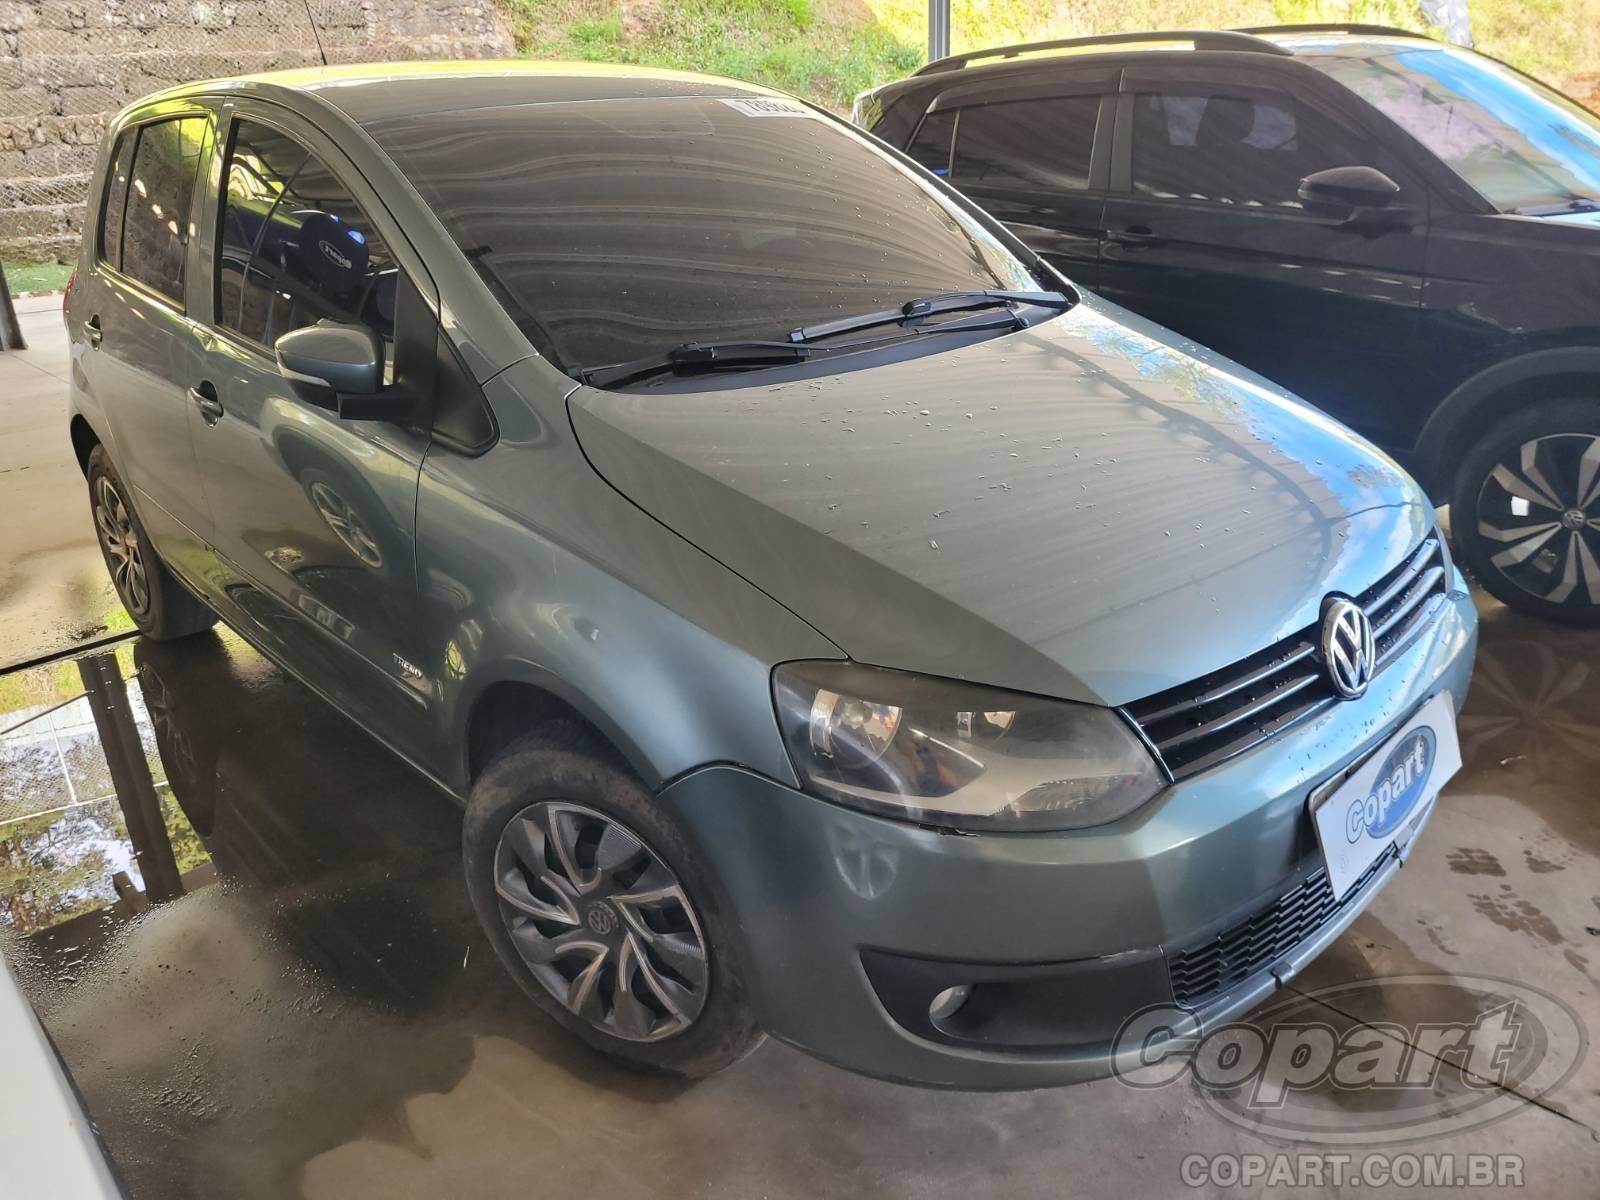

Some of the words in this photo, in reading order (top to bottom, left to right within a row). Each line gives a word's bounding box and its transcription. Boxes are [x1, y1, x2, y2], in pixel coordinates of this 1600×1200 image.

[392, 652, 423, 679] TREND
[1325, 598, 1375, 698] VW
[1346, 733, 1425, 844] Copart
